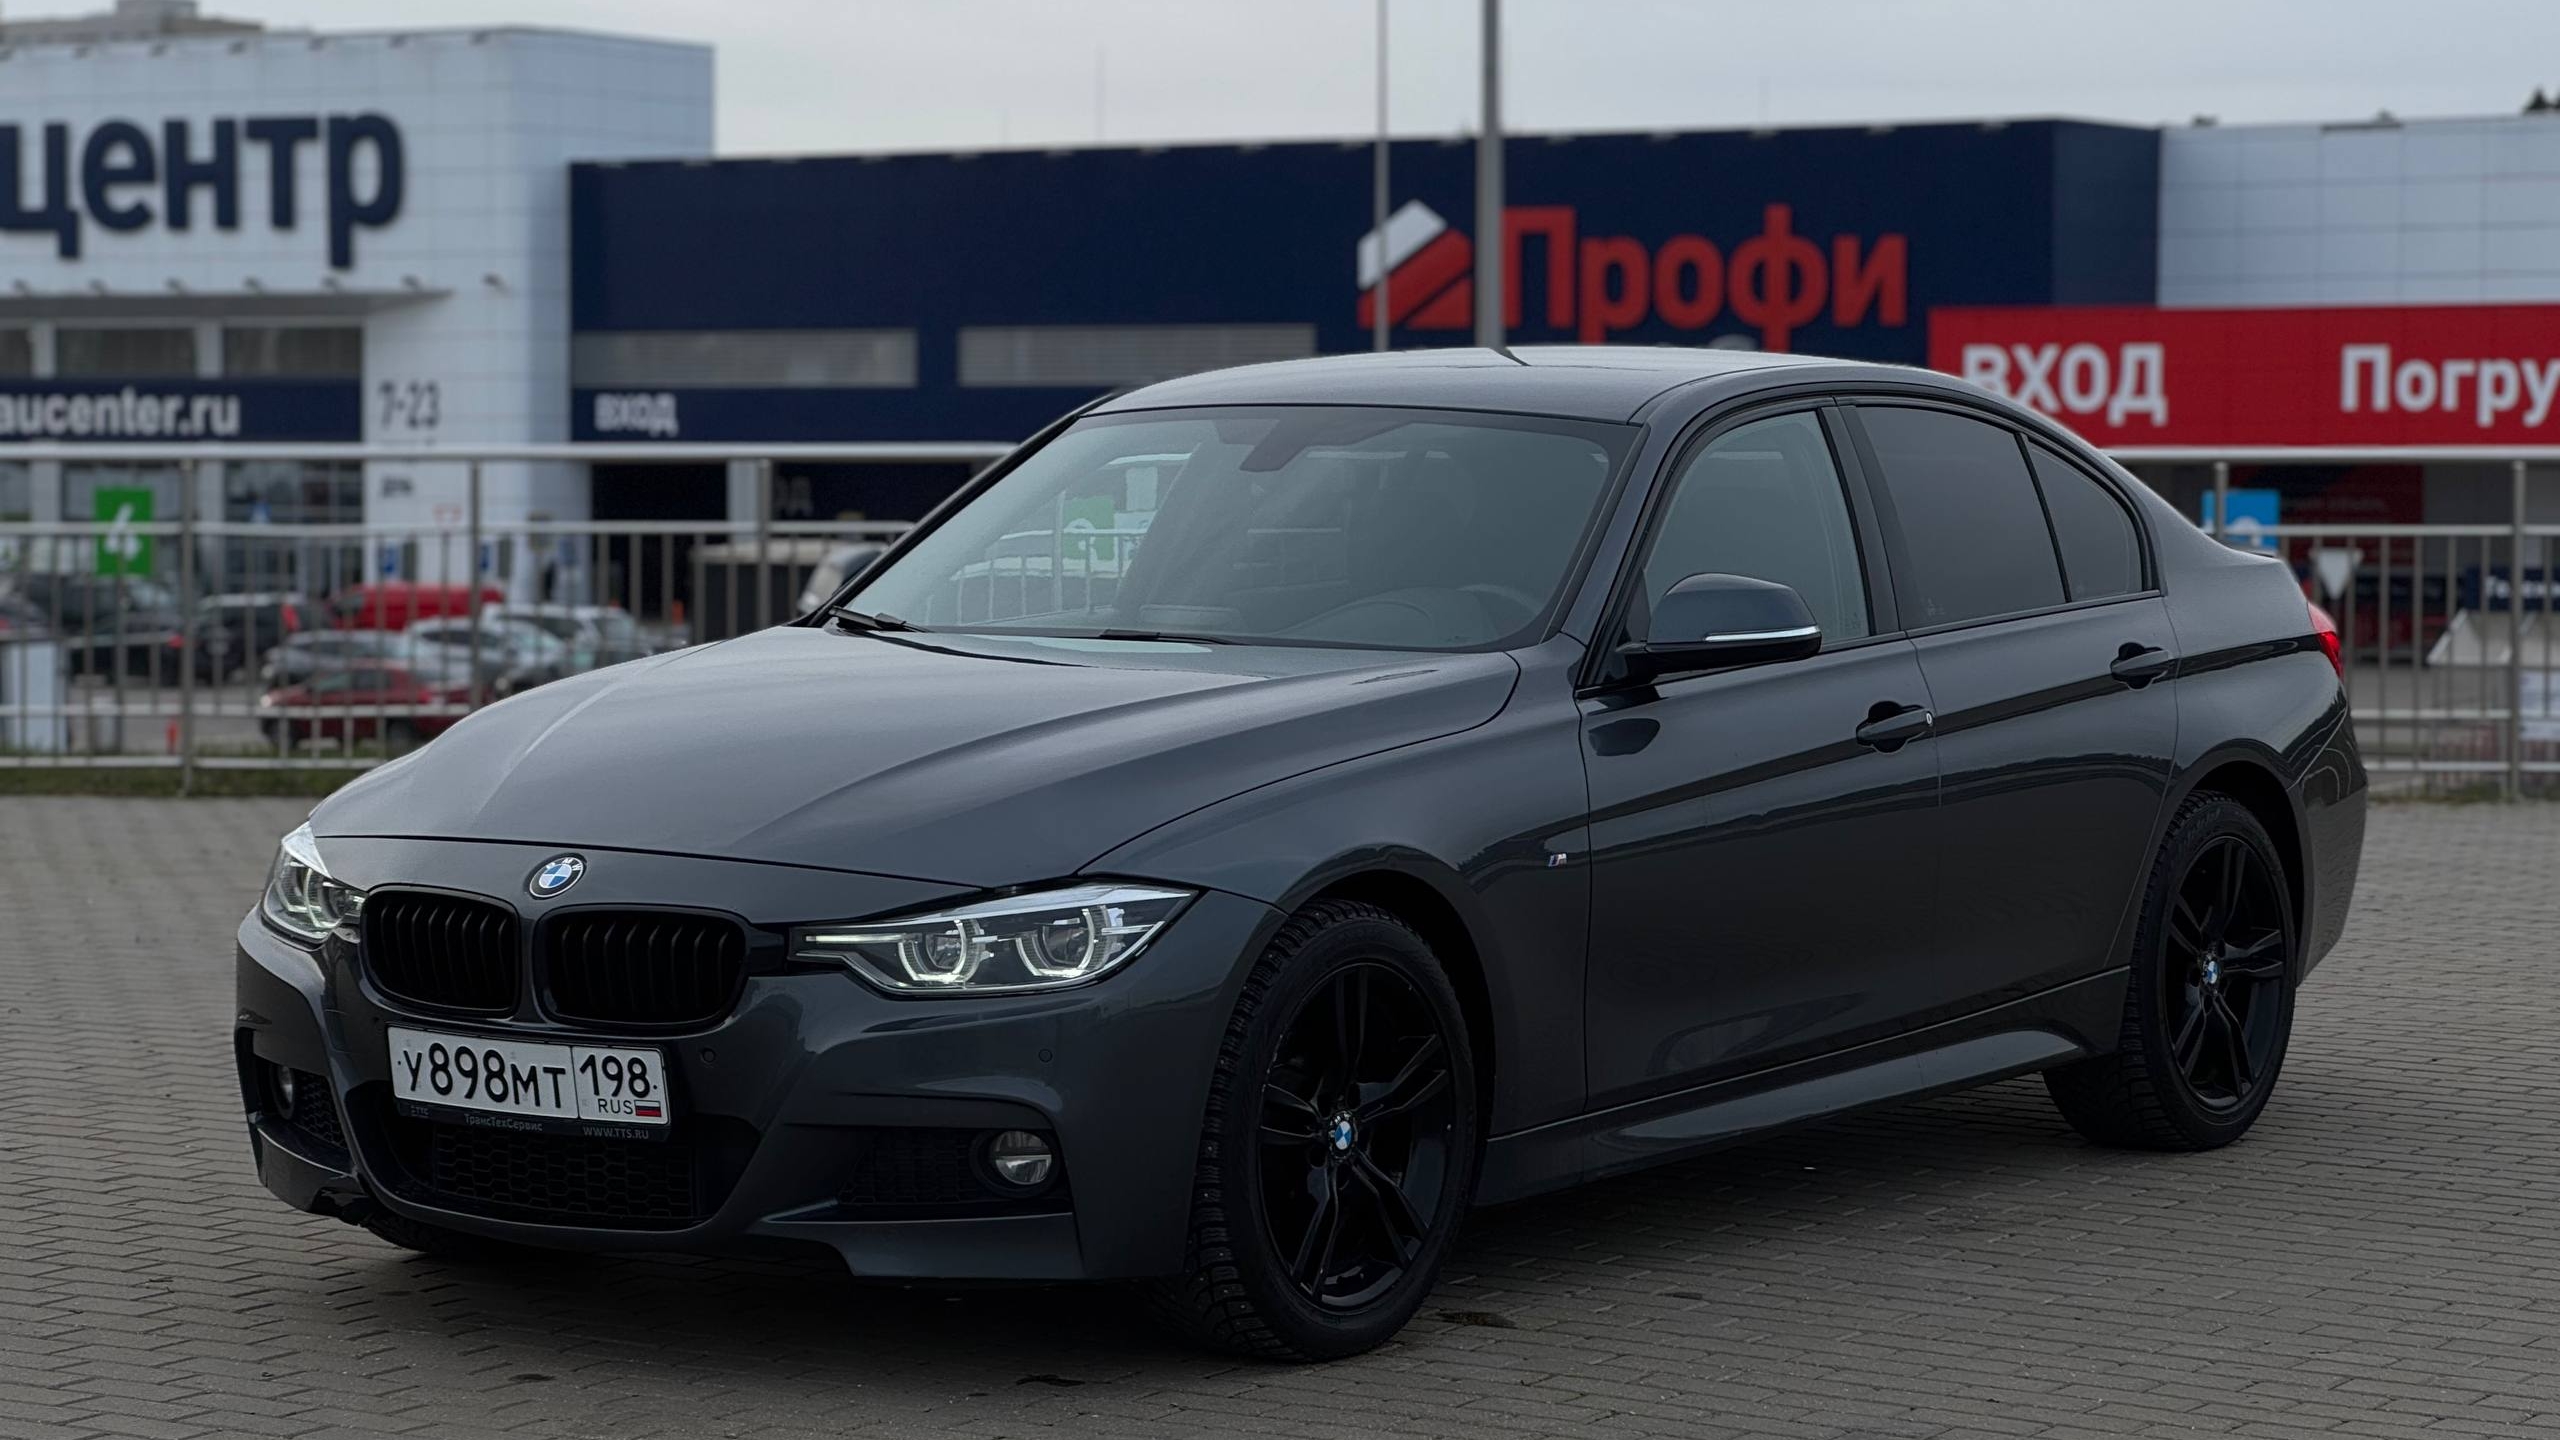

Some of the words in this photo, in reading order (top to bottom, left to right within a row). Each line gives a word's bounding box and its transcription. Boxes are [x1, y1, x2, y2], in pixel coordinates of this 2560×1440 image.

[0, 111, 406, 270] центр
[1502, 204, 1908, 352] Профи
[594, 391, 679, 439] ВХОД
[1961, 342, 2169, 428] ВХОД
[2340, 342, 2560, 429] Погру
[579, 1053, 651, 1099] 198
[597, 1098, 634, 1116] RUS
